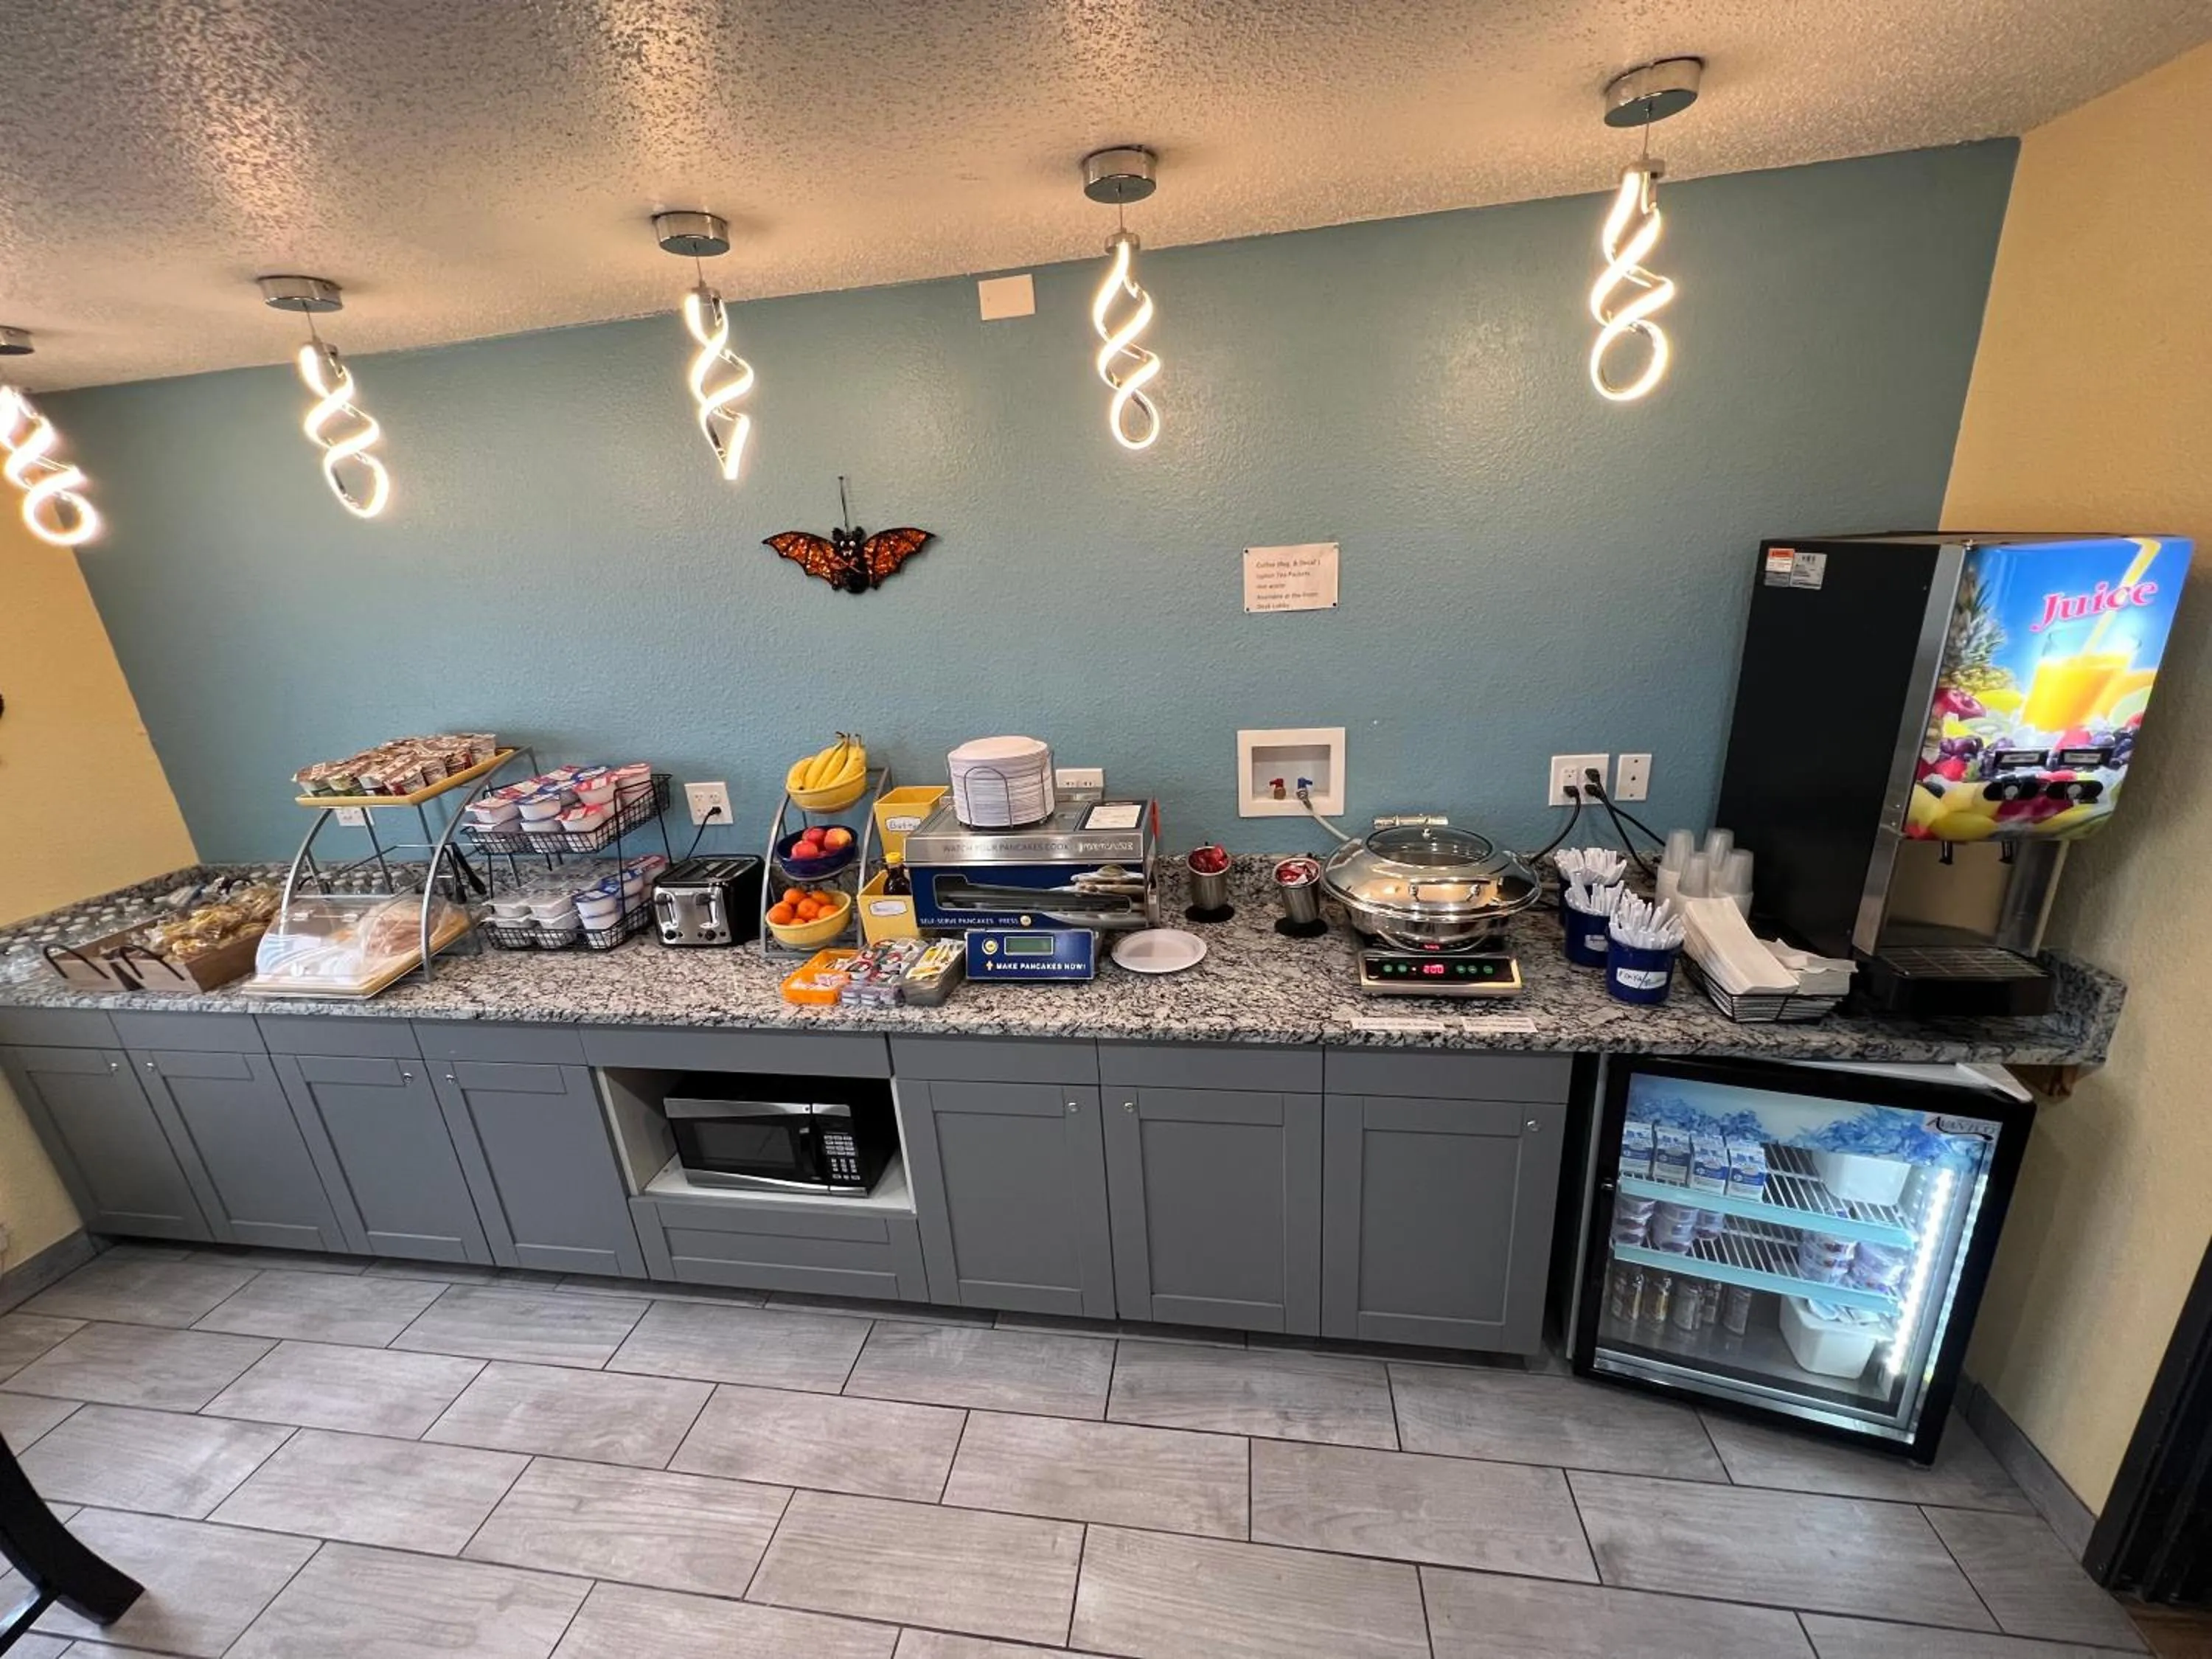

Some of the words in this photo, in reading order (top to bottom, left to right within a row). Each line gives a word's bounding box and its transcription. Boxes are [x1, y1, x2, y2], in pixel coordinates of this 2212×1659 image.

[2029, 581, 2158, 632] Juice
[996, 962, 1018, 970] MAKE
[1020, 961, 1062, 970] PANCAKES
[1064, 961, 1086, 970] NOW!
